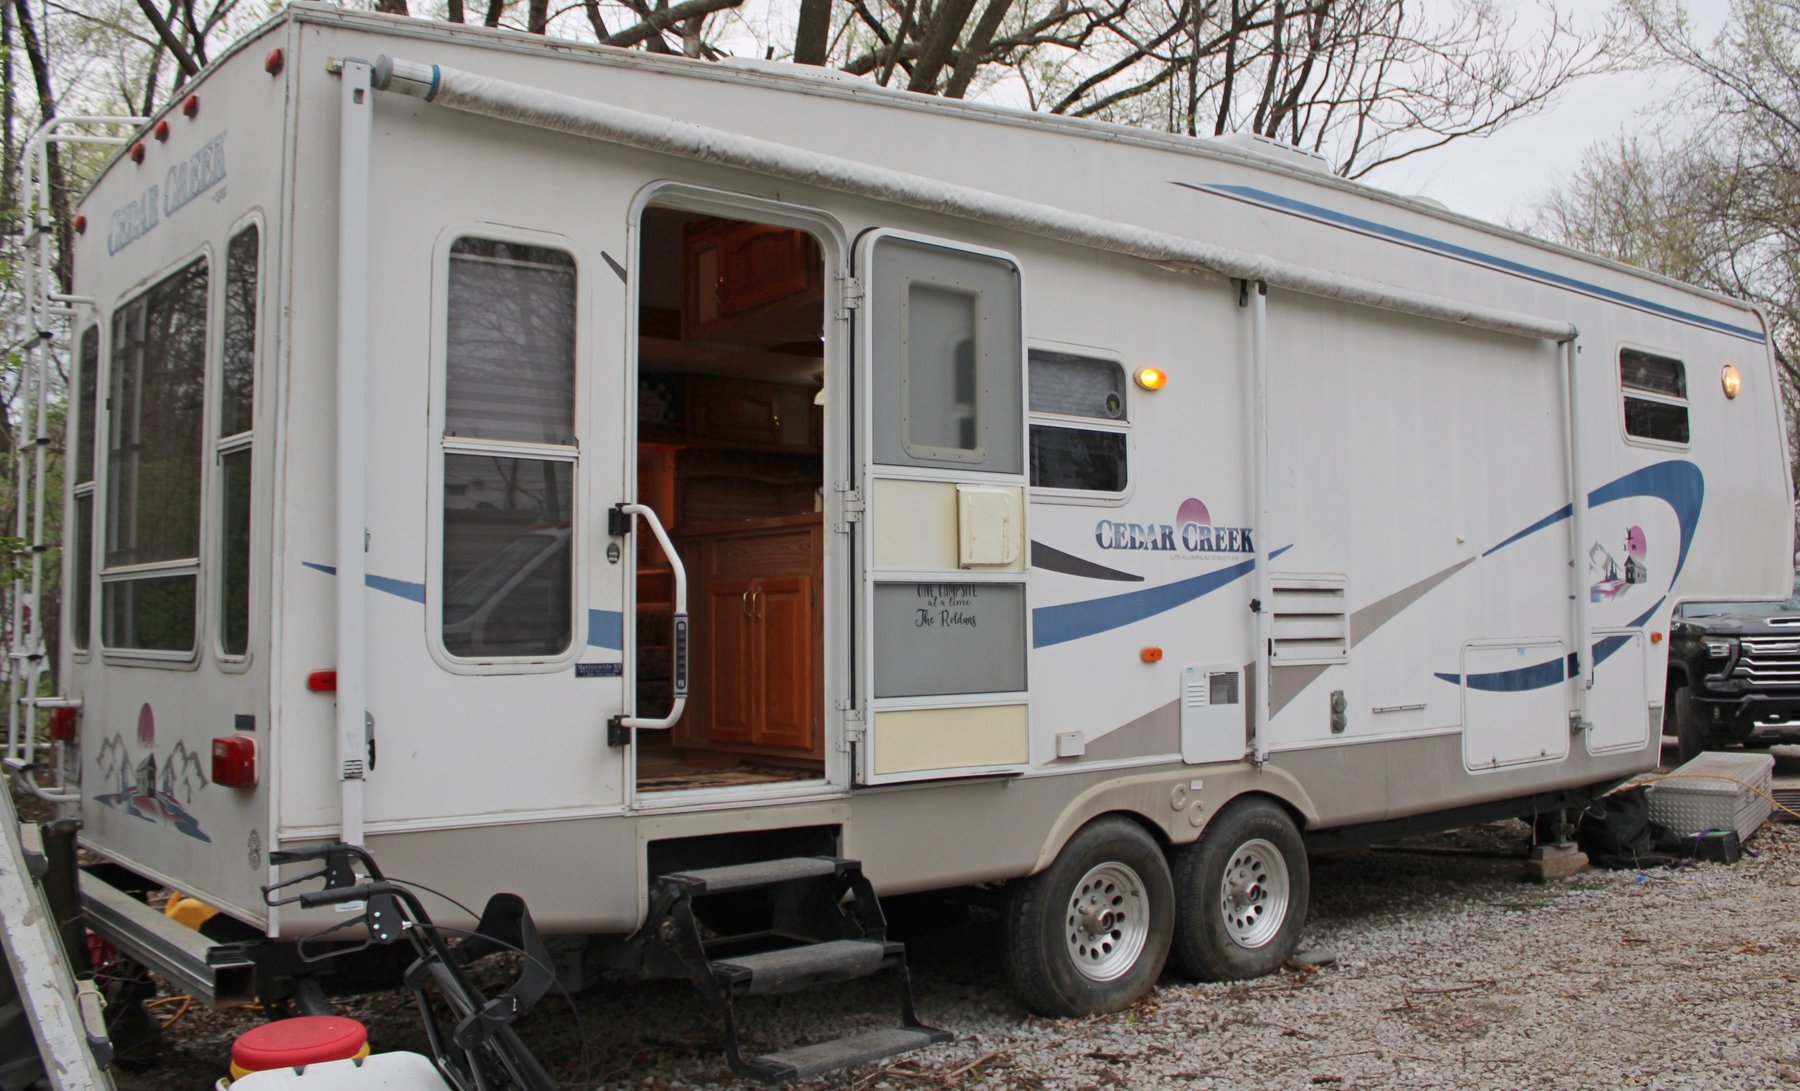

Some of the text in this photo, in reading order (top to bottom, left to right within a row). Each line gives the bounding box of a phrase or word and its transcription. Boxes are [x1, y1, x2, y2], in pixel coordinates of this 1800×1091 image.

[107, 130, 227, 257] CEDAR CREEK
[1095, 519, 1255, 553] CEDAR CREEK
[949, 597, 971, 607] time
[914, 608, 935, 627] The
